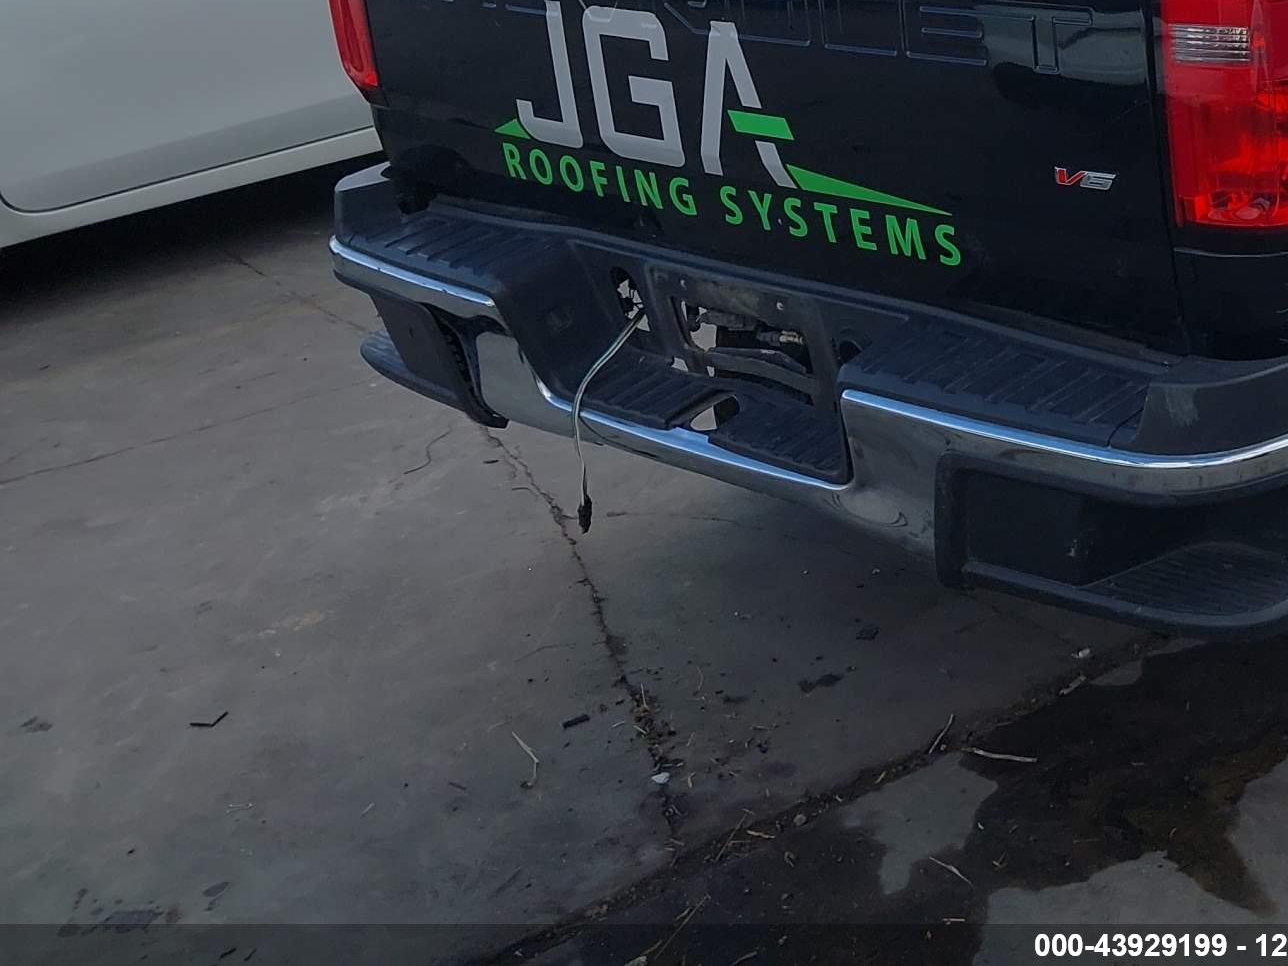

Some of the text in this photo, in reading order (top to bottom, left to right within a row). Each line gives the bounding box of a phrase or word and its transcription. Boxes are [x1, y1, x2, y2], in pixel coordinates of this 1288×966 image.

[516, 0, 795, 189] JGA
[502, 142, 963, 266] ROOFING SYSTEMS
[1054, 166, 1116, 191] V6
